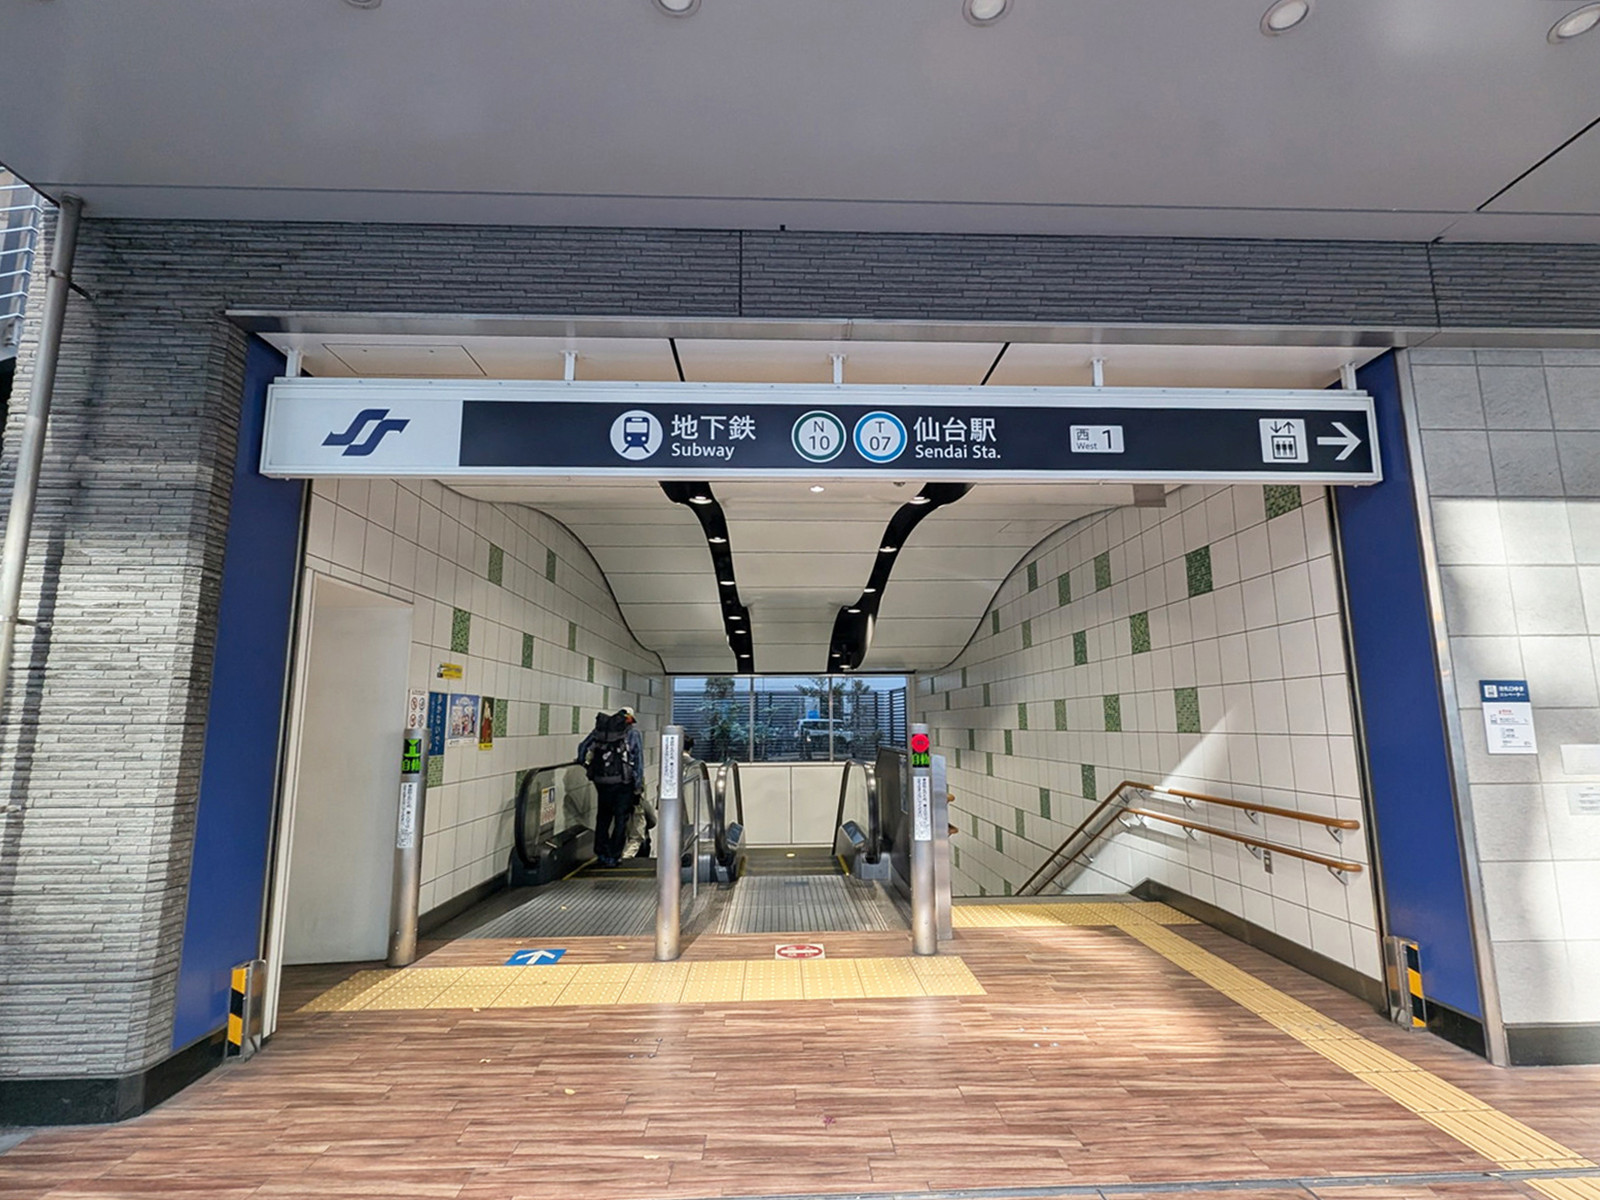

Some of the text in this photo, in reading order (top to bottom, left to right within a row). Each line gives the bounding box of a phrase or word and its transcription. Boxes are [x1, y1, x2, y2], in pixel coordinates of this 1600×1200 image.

[671, 414, 756, 441] 地下鉄
[813, 421, 824, 433] N
[875, 421, 885, 433] T
[914, 416, 996, 443] 仙台駅
[1075, 428, 1090, 441] 西
[809, 435, 830, 450] 10
[869, 436, 891, 451] 07
[1075, 441, 1098, 450] West
[1101, 428, 1112, 450] 1
[672, 442, 735, 461] Subway
[915, 444, 1001, 459] Sendai Sta.
